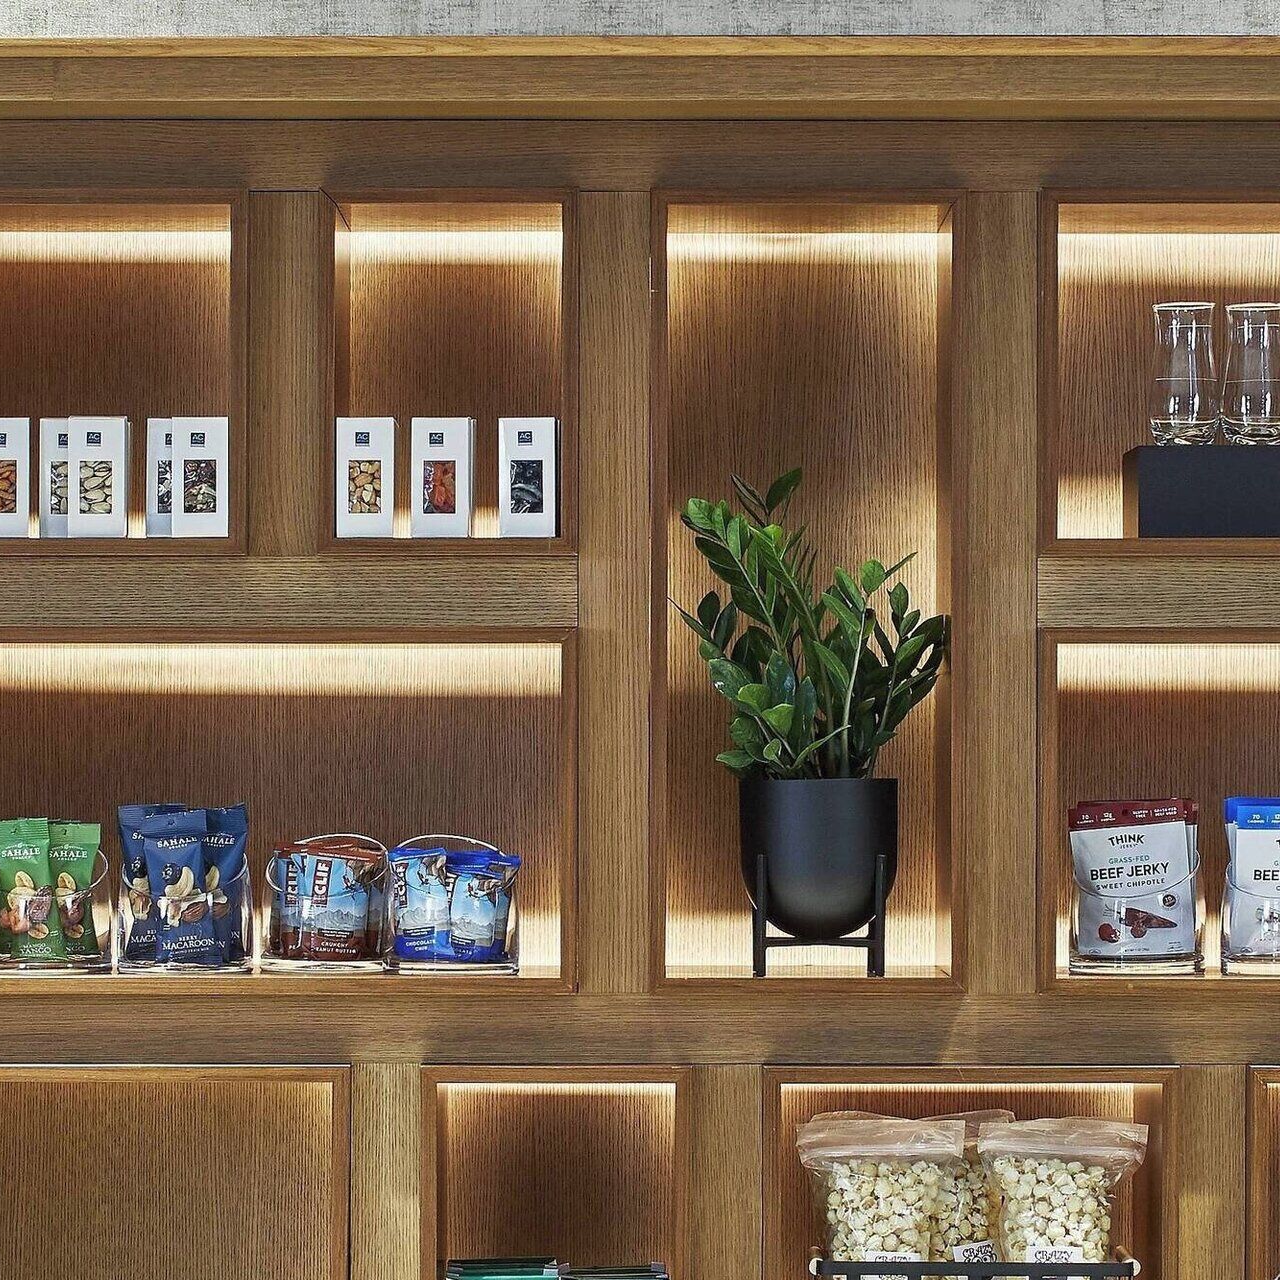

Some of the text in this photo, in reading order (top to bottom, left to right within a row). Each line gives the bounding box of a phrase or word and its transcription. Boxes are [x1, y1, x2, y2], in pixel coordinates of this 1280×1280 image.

[157, 837, 198, 849] SAHALE
[1108, 834, 1145, 847] THINK
[2, 848, 40, 859] SAHALE
[1090, 861, 1169, 881] BEEF JERKY
[1095, 877, 1166, 891] SWEET CHIPOTLE
[162, 938, 215, 951] MACAROON
[962, 1245, 995, 1258] CRAZY
[1034, 1250, 1073, 1260] CRAZY
